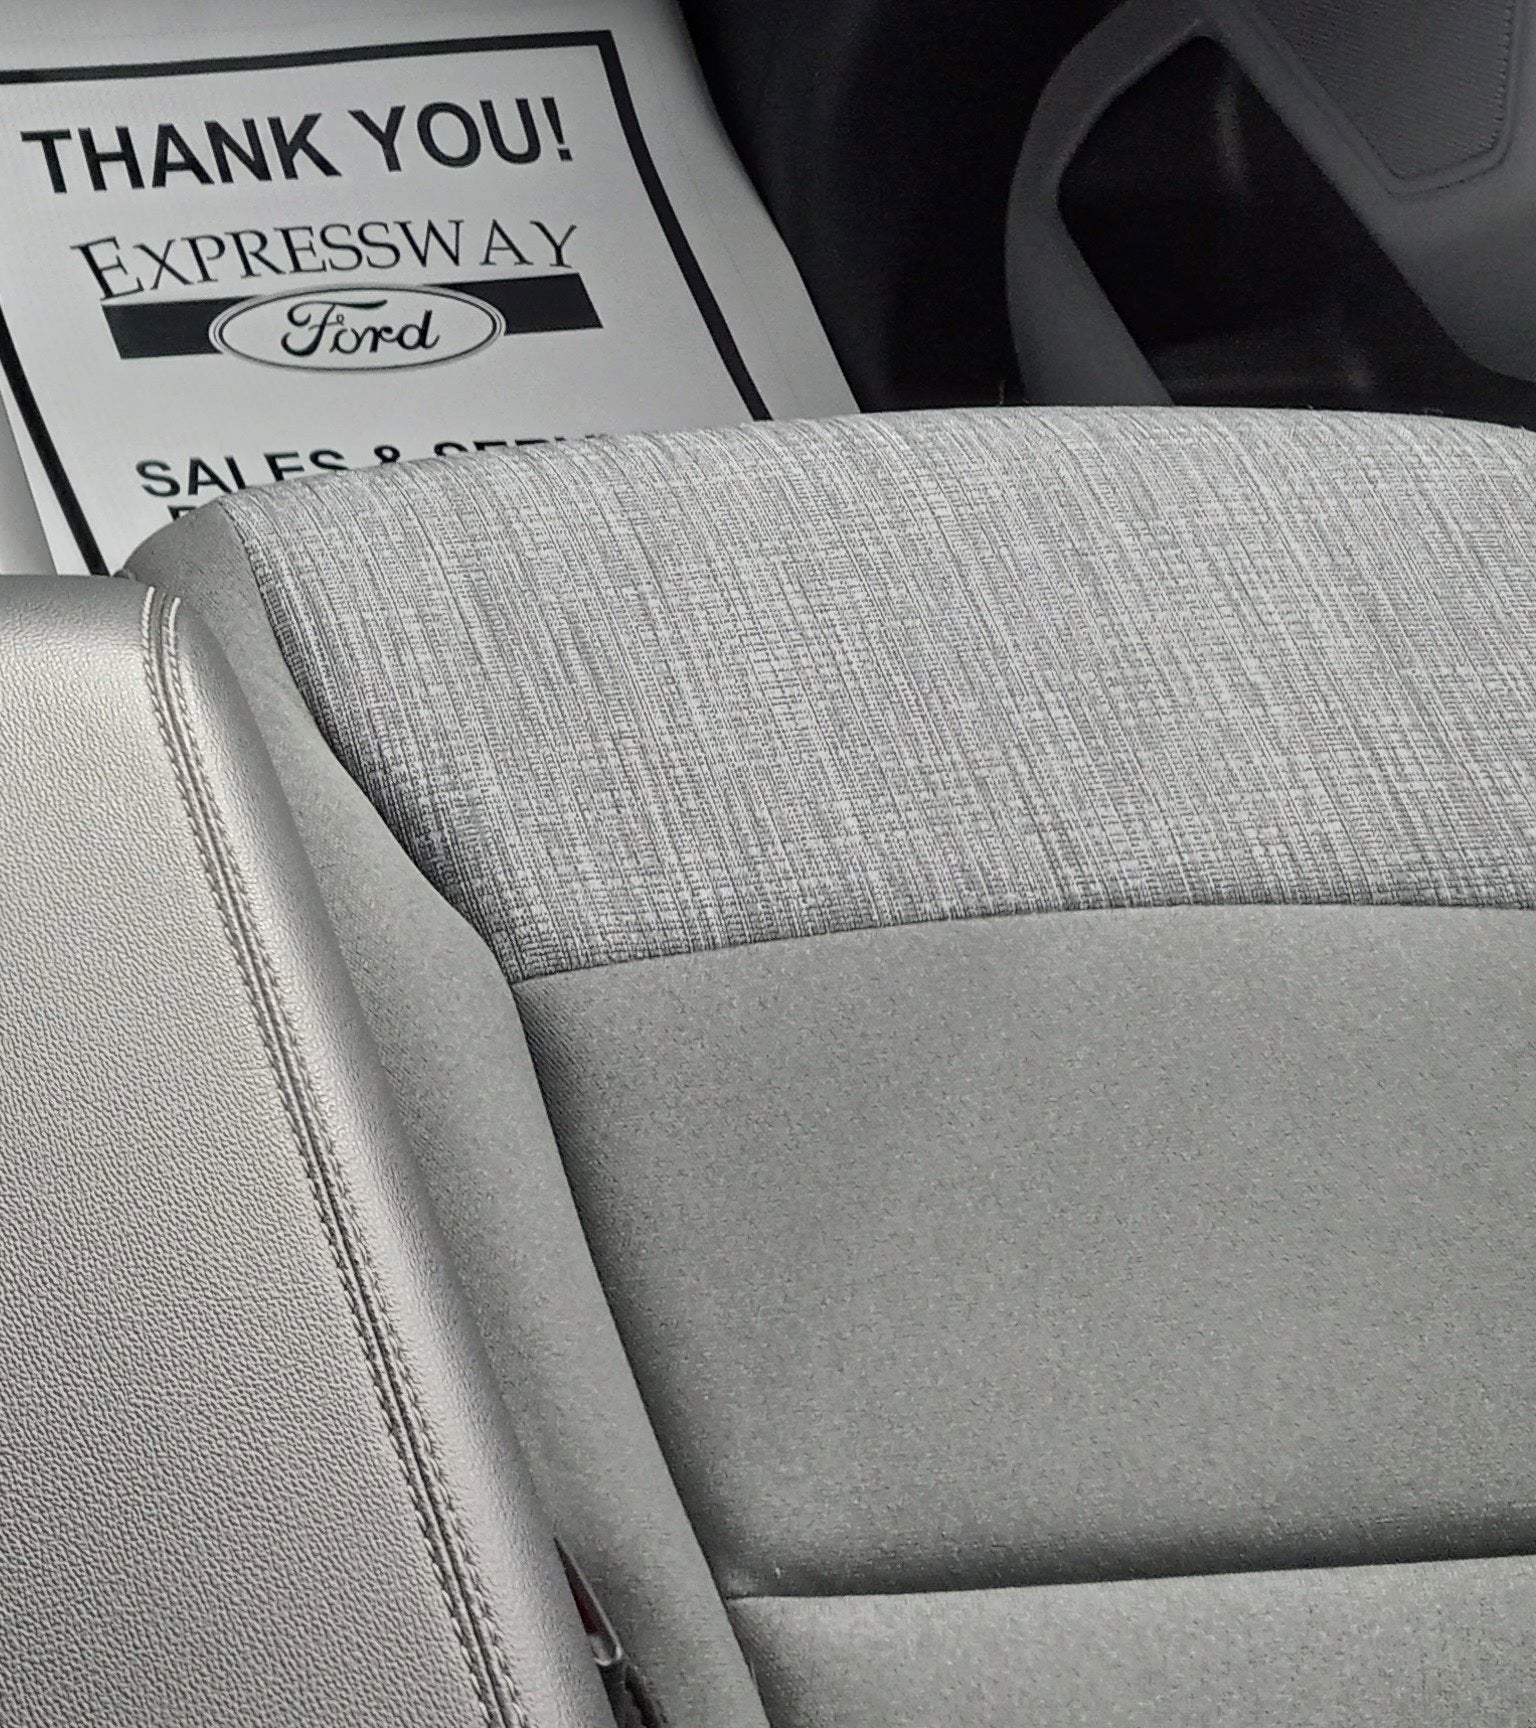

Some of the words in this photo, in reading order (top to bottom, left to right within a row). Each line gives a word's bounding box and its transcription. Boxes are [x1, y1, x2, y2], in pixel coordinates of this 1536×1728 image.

[20, 112, 342, 194] THANK
[349, 96, 575, 173] YOU!
[281, 298, 442, 358] Ford
